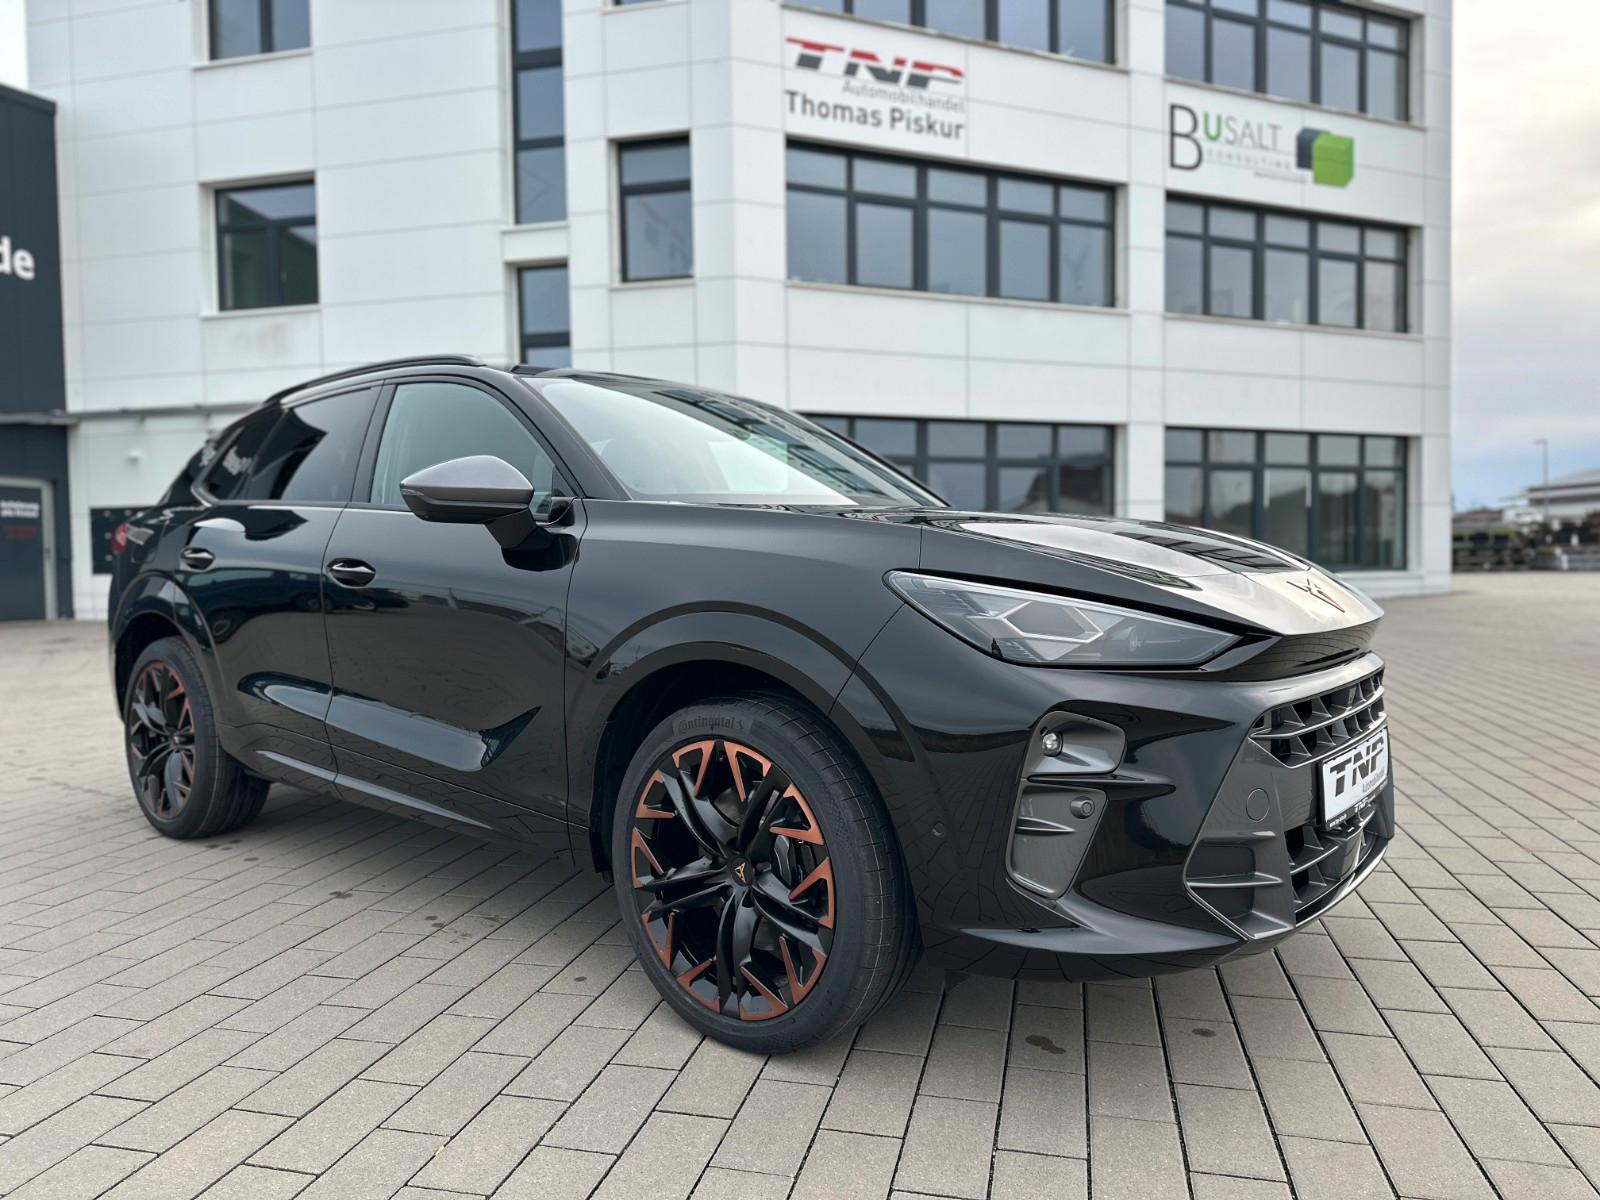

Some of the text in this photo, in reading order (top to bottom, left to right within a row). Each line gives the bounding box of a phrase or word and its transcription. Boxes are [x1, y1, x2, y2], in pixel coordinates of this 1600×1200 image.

[785, 36, 965, 89] TNP
[785, 89, 965, 140] Thomas Piskur
[1169, 103, 1282, 172] BUSALT
[679, 715, 736, 734] Continental
[1329, 735, 1385, 798] TNP
